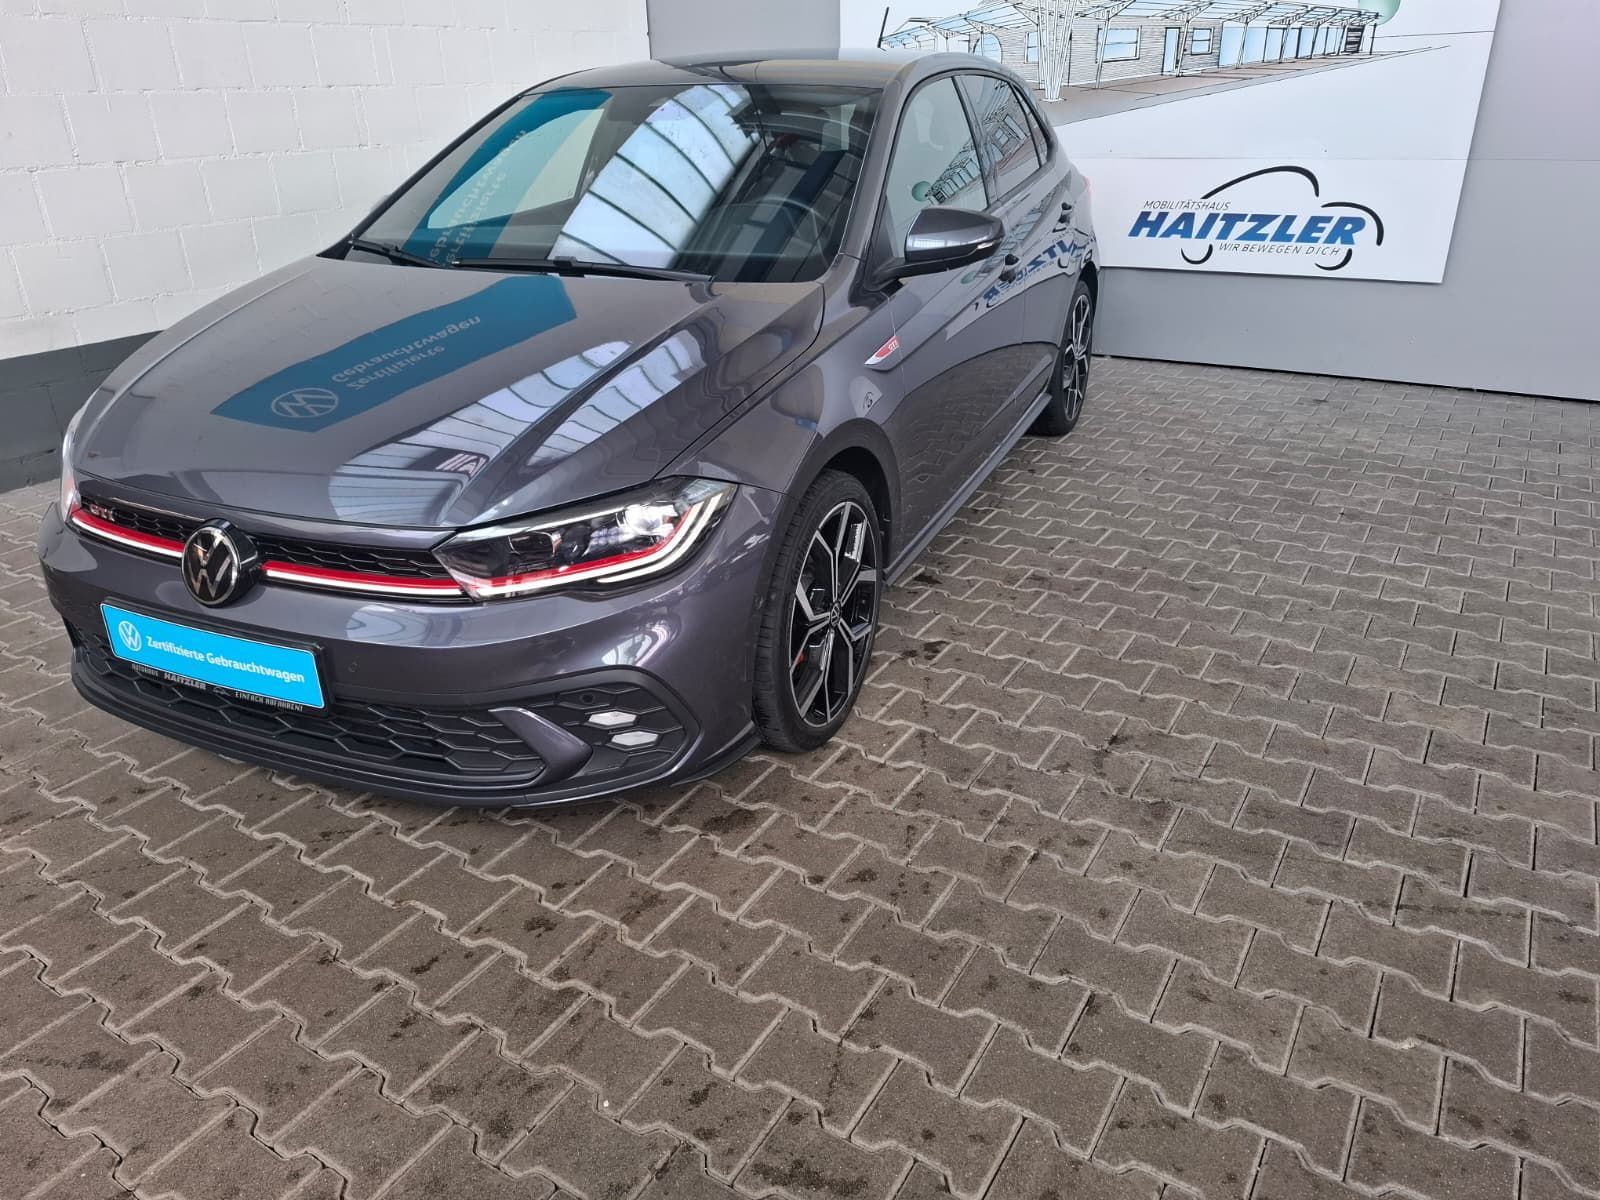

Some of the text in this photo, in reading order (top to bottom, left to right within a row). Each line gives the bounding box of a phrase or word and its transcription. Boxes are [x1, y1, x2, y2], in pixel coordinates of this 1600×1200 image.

[1143, 200, 1231, 211] MOBILITÄTSHAUS
[1127, 211, 1367, 245] HAITZLER
[1219, 242, 1341, 256] WIR BEWEGEN DICH
[88, 503, 116, 522] GTI
[146, 635, 205, 662] Zertifizierte
[206, 652, 305, 684] Gebrauchtwagen
[164, 672, 206, 690] HAITZLER
